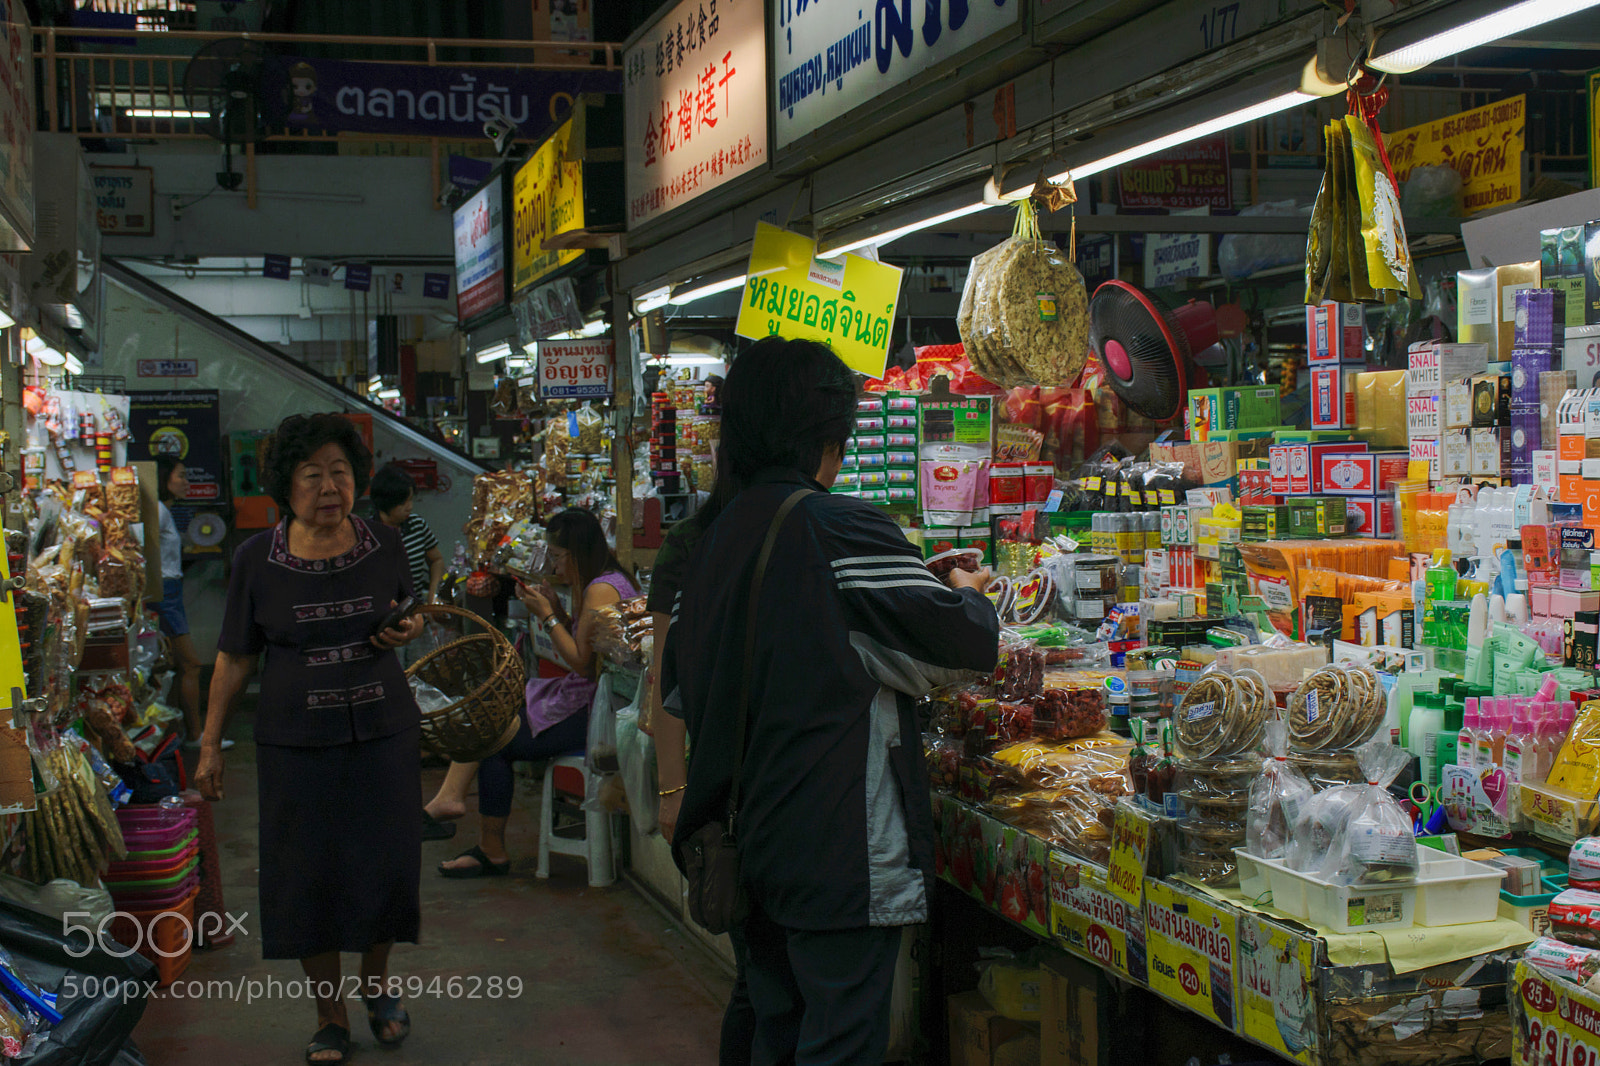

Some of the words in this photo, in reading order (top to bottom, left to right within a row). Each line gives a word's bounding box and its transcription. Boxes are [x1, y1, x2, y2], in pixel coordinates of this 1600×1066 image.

[335, 73, 529, 125] ตลาดนี้รับ
[749, 275, 894, 350] หมูยอสจินต์
[1409, 353, 1439, 369] SNAIL
[1586, 342, 1600, 367] S
[1410, 368, 1439, 383] WHITE
[1409, 399, 1437, 414] SNAIL
[1409, 413, 1437, 428] WHITE
[1410, 443, 1438, 458] SNAIL
[1586, 494, 1598, 512] C
[1086, 931, 1110, 962] 120
[1178, 967, 1198, 991] 120
